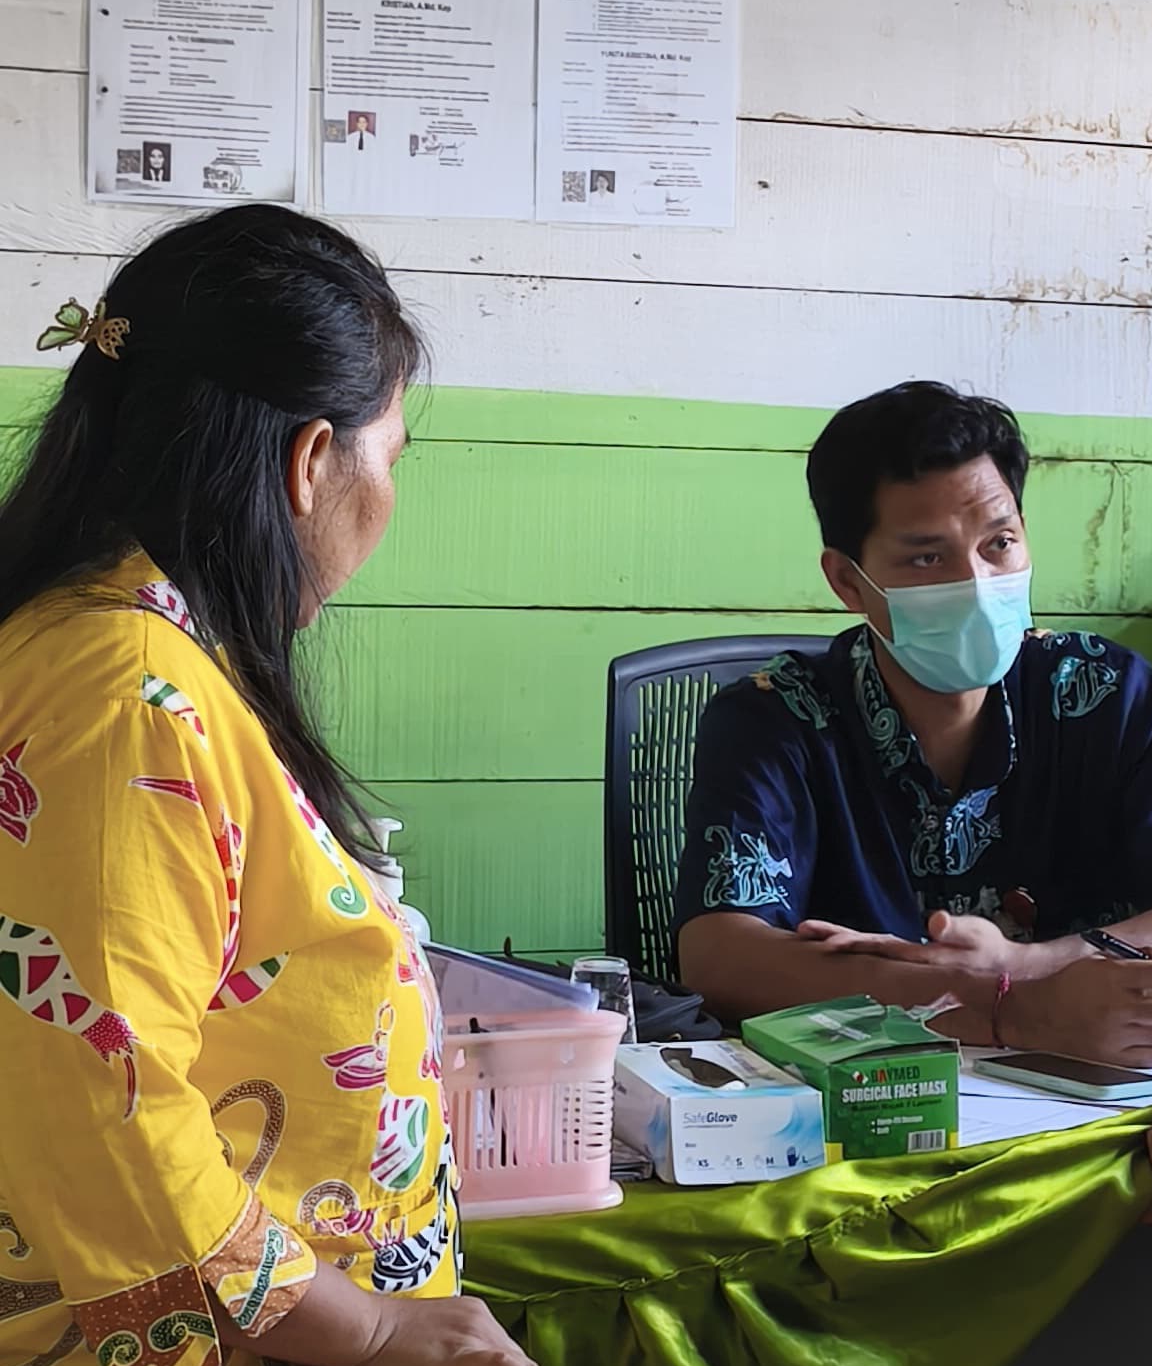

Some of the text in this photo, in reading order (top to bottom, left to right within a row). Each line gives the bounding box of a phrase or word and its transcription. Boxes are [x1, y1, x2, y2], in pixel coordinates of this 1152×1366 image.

[842, 1080, 947, 1104] SURGICAL FACE MASK
[683, 1111, 738, 1124] SafeGlove
